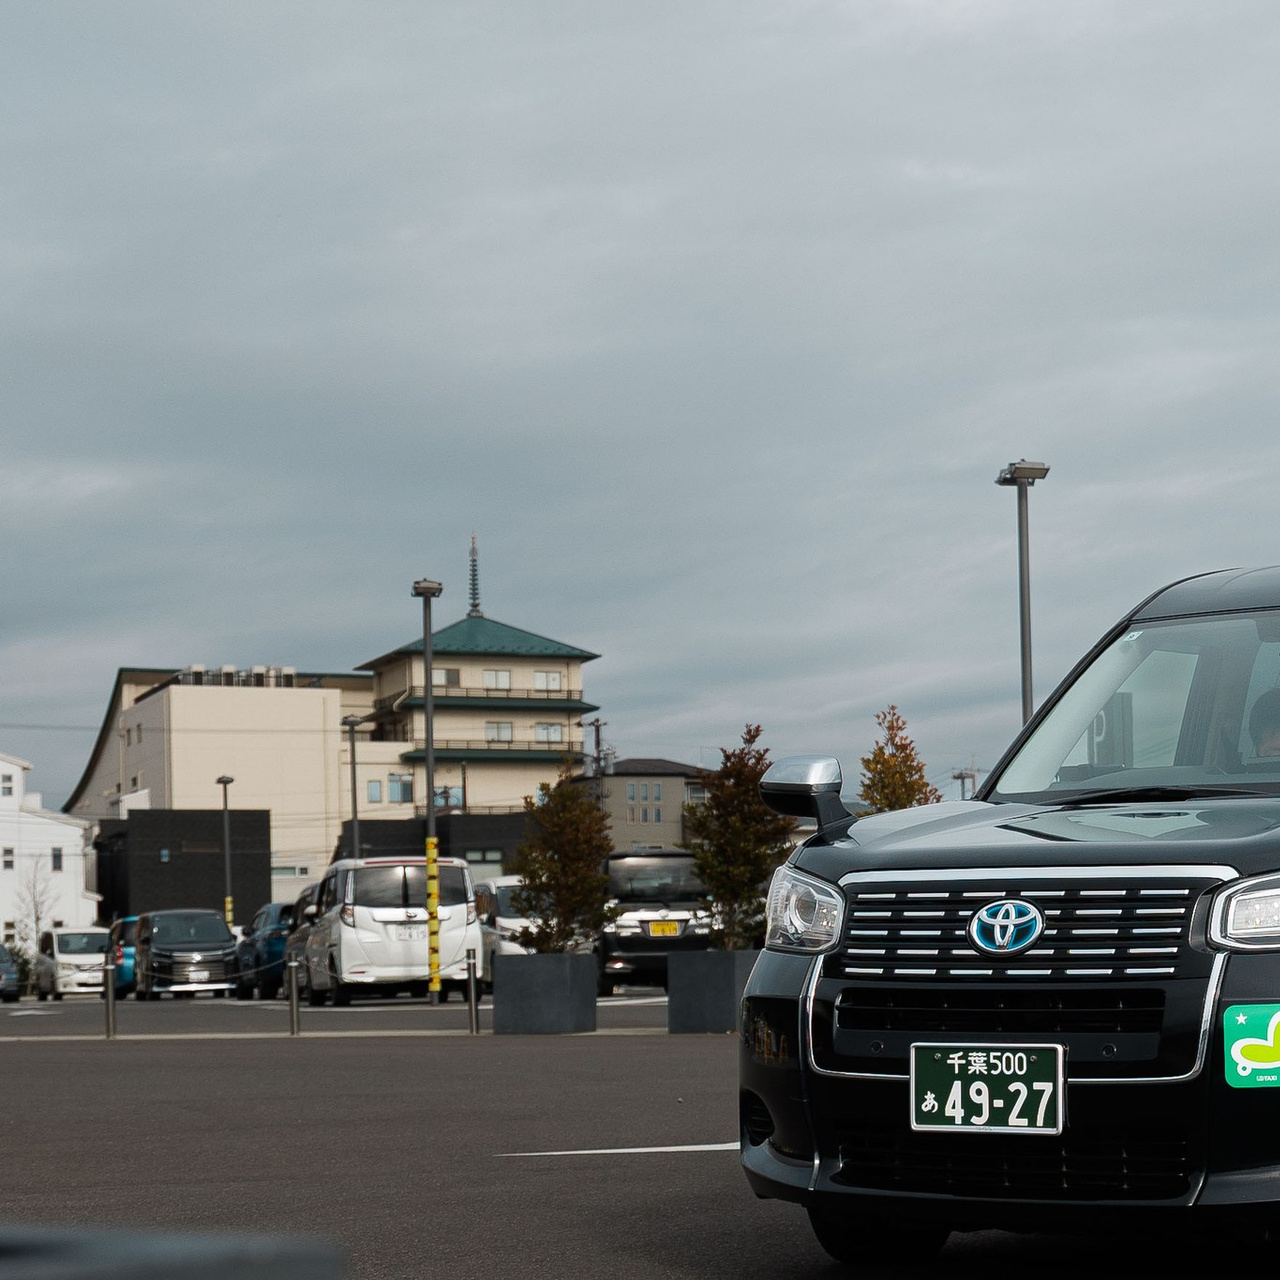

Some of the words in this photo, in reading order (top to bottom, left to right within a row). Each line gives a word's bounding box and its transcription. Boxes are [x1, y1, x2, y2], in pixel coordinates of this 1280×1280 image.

[947, 1052, 1027, 1075] 千葉500
[921, 1091, 939, 1113] あ
[945, 1080, 1054, 1127] 49-27
